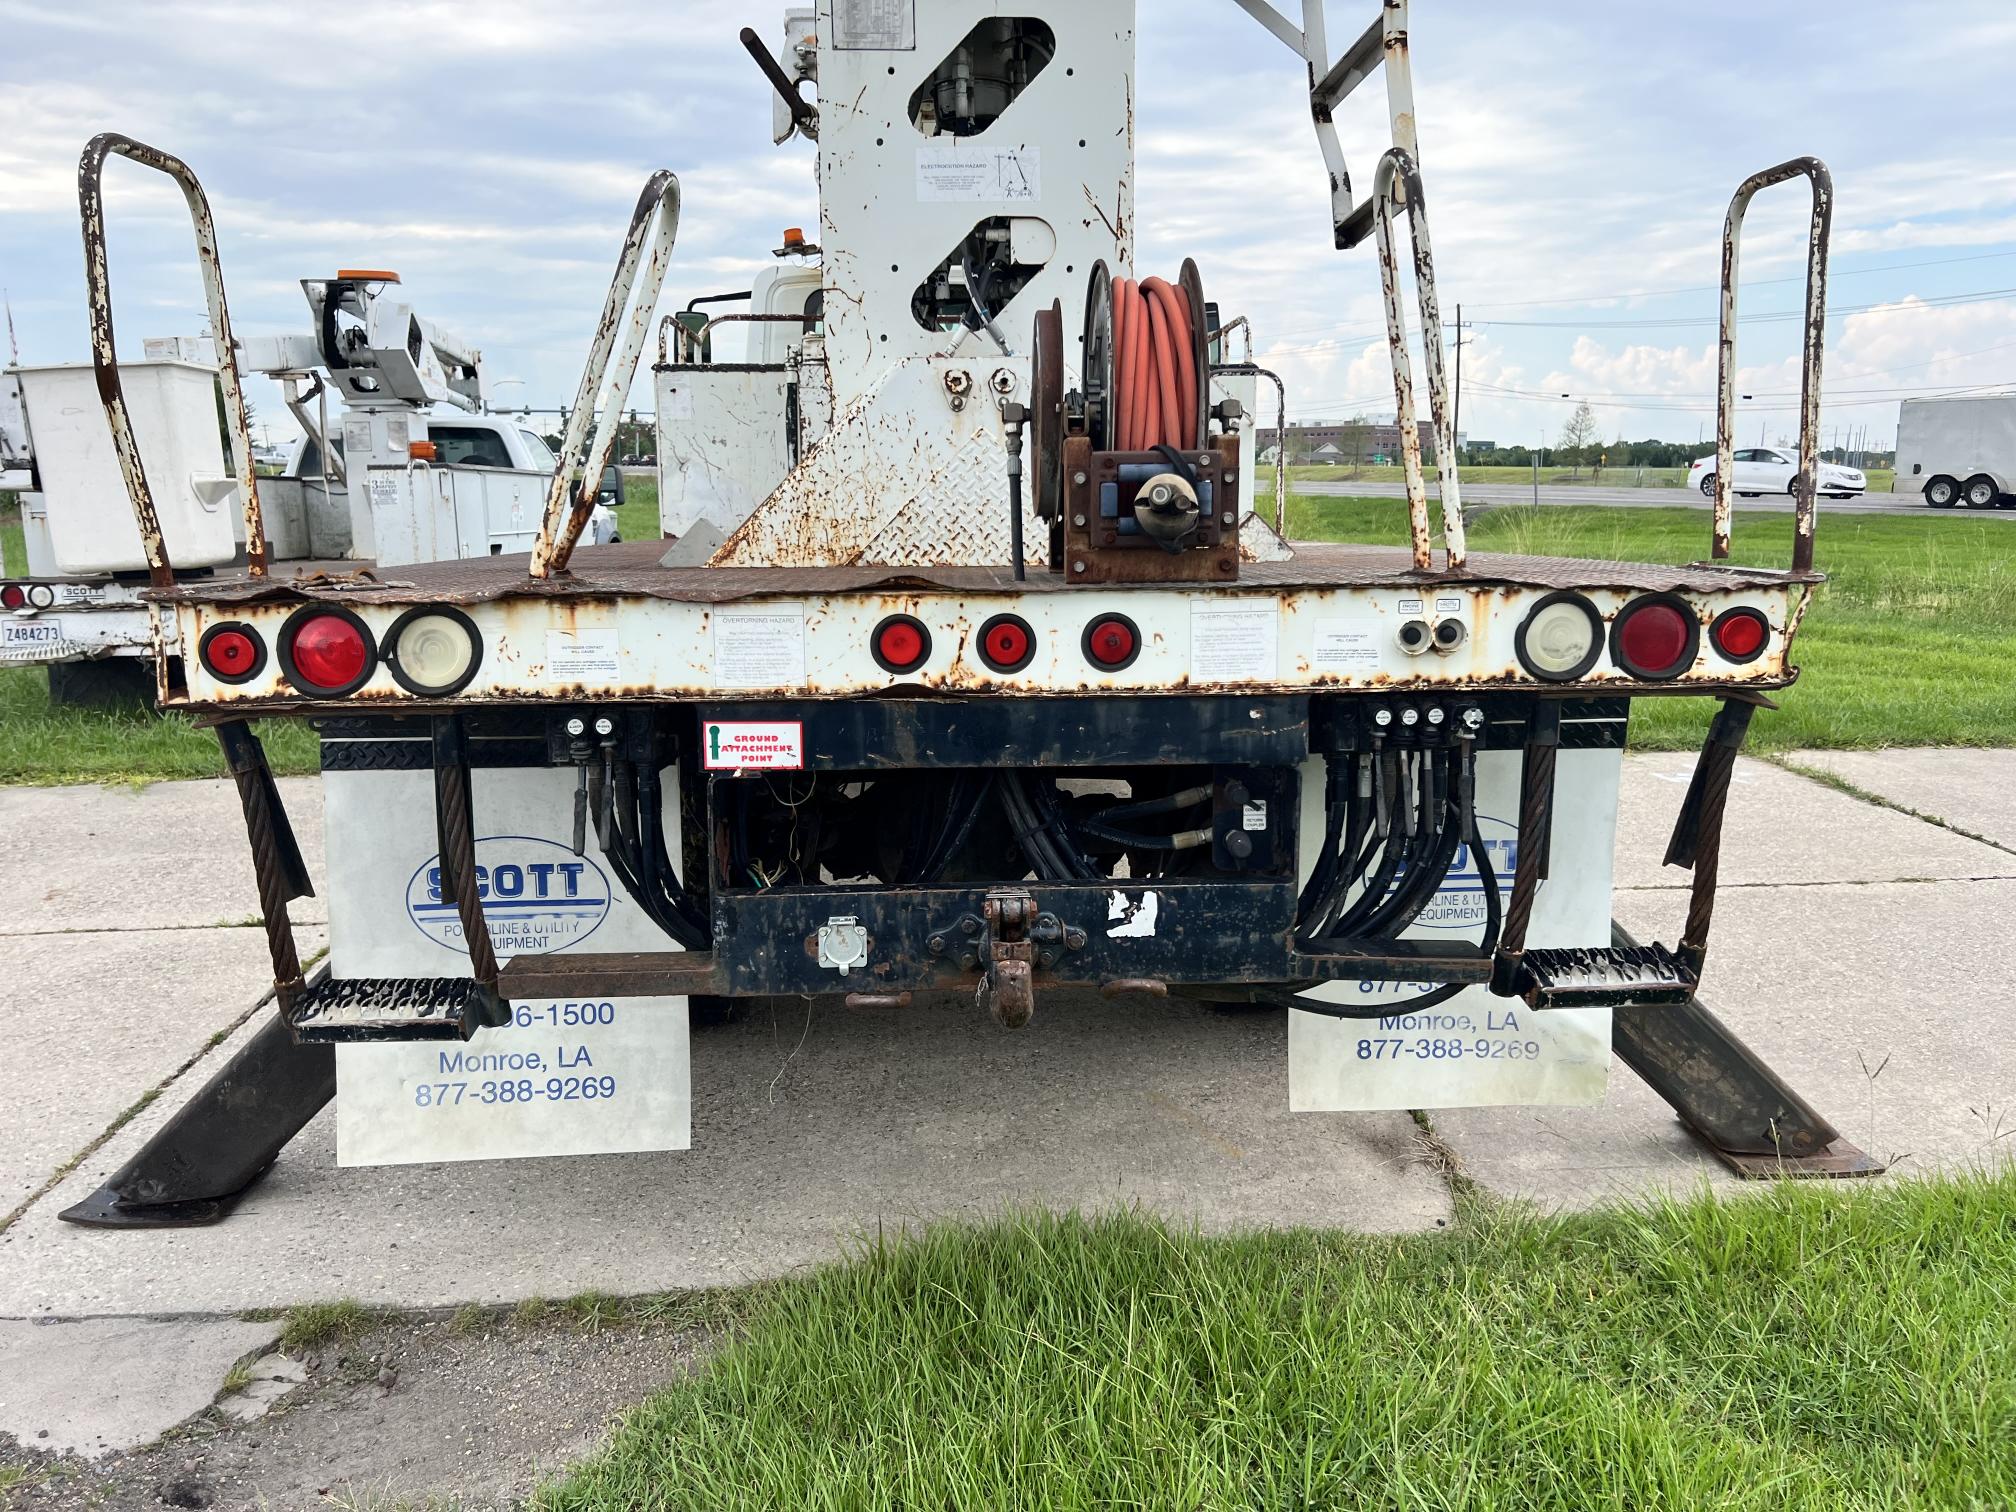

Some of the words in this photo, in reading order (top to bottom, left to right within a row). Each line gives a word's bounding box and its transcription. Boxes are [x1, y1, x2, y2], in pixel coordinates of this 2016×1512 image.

[6, 628, 58, 641] Z484273
[1462, 894, 1469, 906] &
[1420, 908, 1486, 920] EQUIPMENT
[522, 922, 530, 934] &
[493, 936, 549, 950] UIPMENT
[1379, 1014, 1477, 1033] Monroe,
[1488, 1011, 1520, 1031] LA
[1357, 1038, 1540, 1060] 877-388-9269
[439, 1051, 547, 1073] Monroe,
[558, 1045, 593, 1068] LA
[415, 1076, 616, 1107] 877-388-9269
